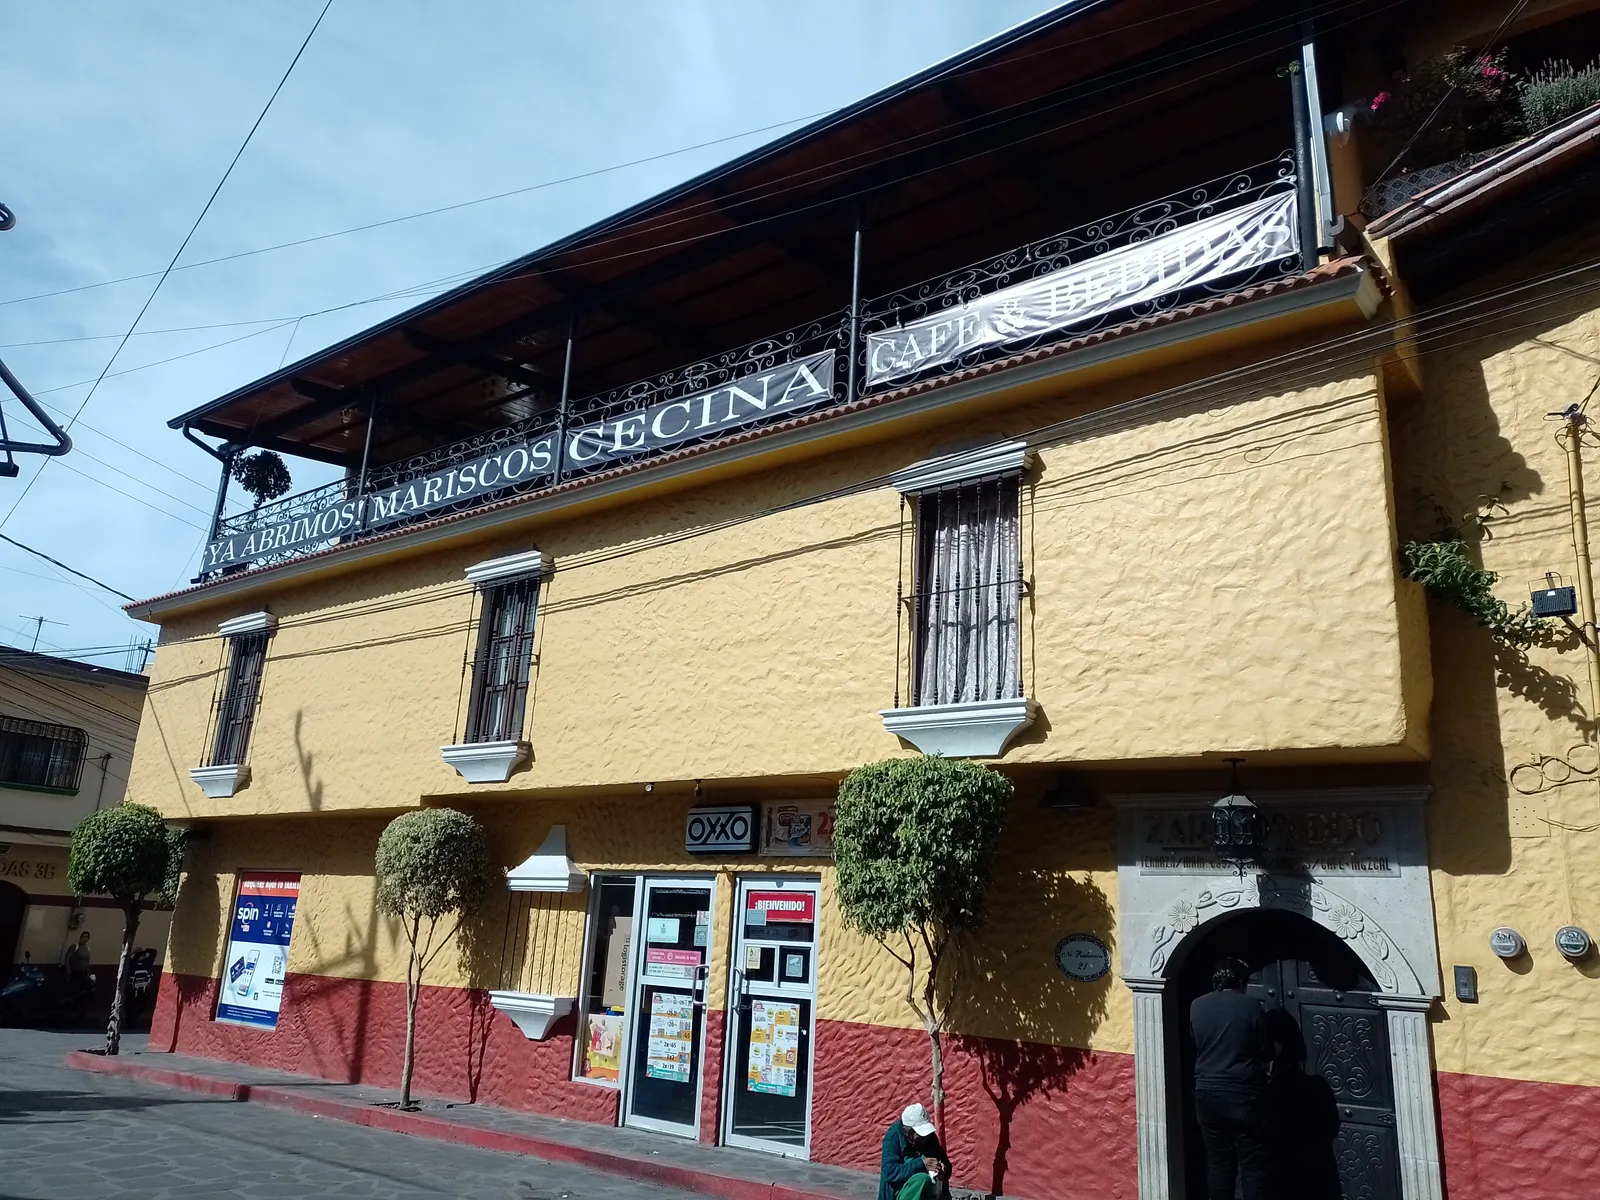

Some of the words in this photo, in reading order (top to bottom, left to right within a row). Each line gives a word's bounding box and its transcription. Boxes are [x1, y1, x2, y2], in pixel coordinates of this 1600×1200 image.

[568, 363, 830, 462] CECINA
[370, 438, 553, 523] MARISCOS
[241, 500, 365, 558] ABRIMOS!
[688, 812, 749, 844] OXXO
[237, 905, 259, 924] spin
[618, 944, 630, 992] logistorage
[1077, 962, 1088, 970] 21
